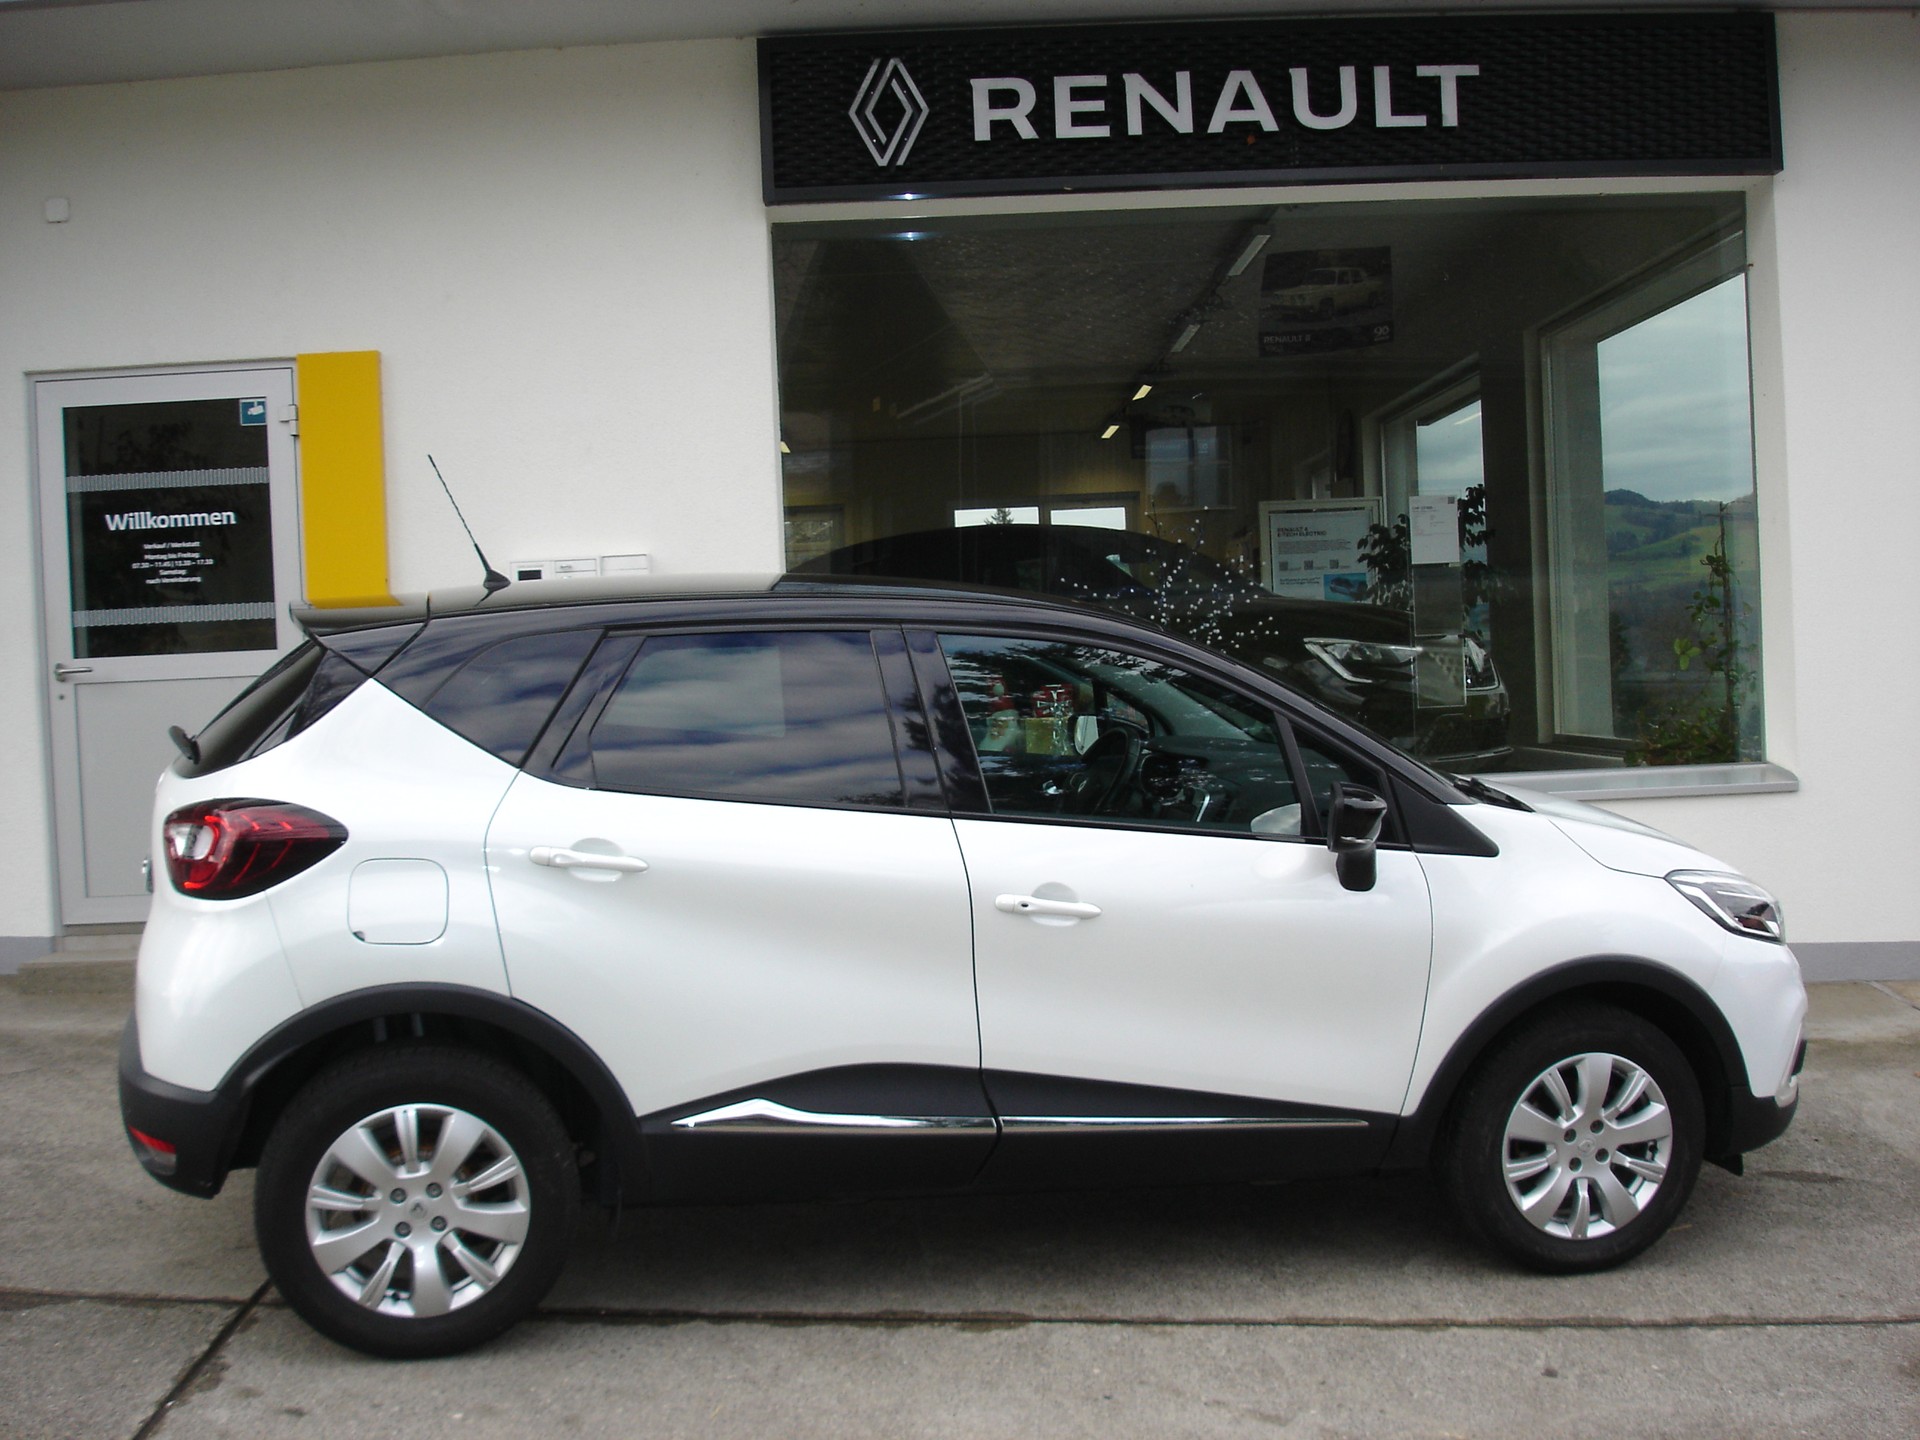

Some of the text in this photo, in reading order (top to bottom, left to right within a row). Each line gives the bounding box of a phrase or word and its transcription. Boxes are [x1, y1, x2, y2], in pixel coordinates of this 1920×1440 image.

[970, 63, 1480, 142] RENAULT
[1263, 334, 1303, 344] RENAULT
[105, 511, 237, 531] Willkommen
